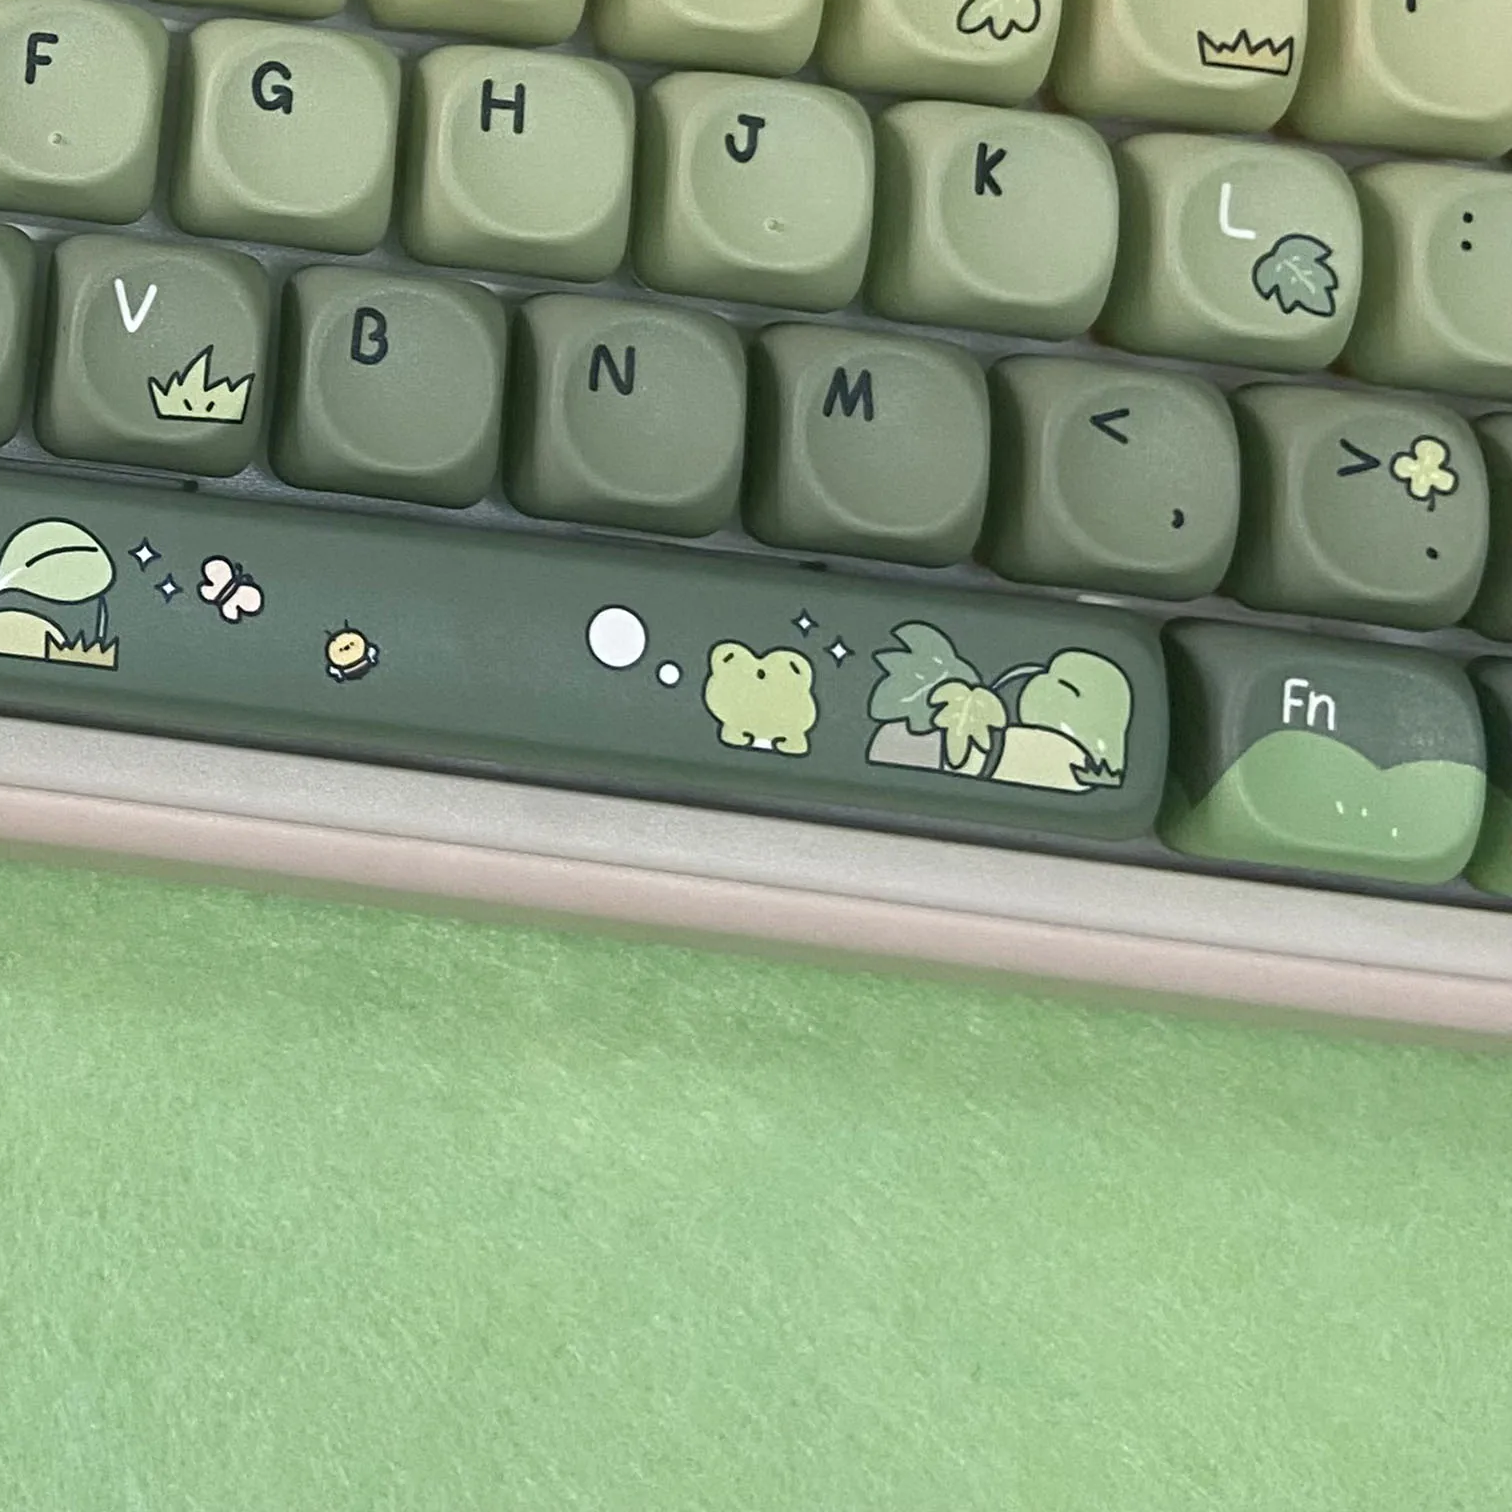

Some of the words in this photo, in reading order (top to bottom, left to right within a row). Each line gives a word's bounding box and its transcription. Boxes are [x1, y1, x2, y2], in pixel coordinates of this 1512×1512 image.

[25, 32, 59, 85] F
[251, 60, 294, 116] G
[481, 78, 526, 135] H
[724, 114, 765, 164] J
[974, 142, 1007, 197] K
[1220, 182, 1257, 240] L
[115, 278, 158, 333] V
[350, 306, 389, 366] B
[588, 343, 636, 396] N
[823, 366, 875, 422] M
[1281, 677, 1337, 731] Fn
